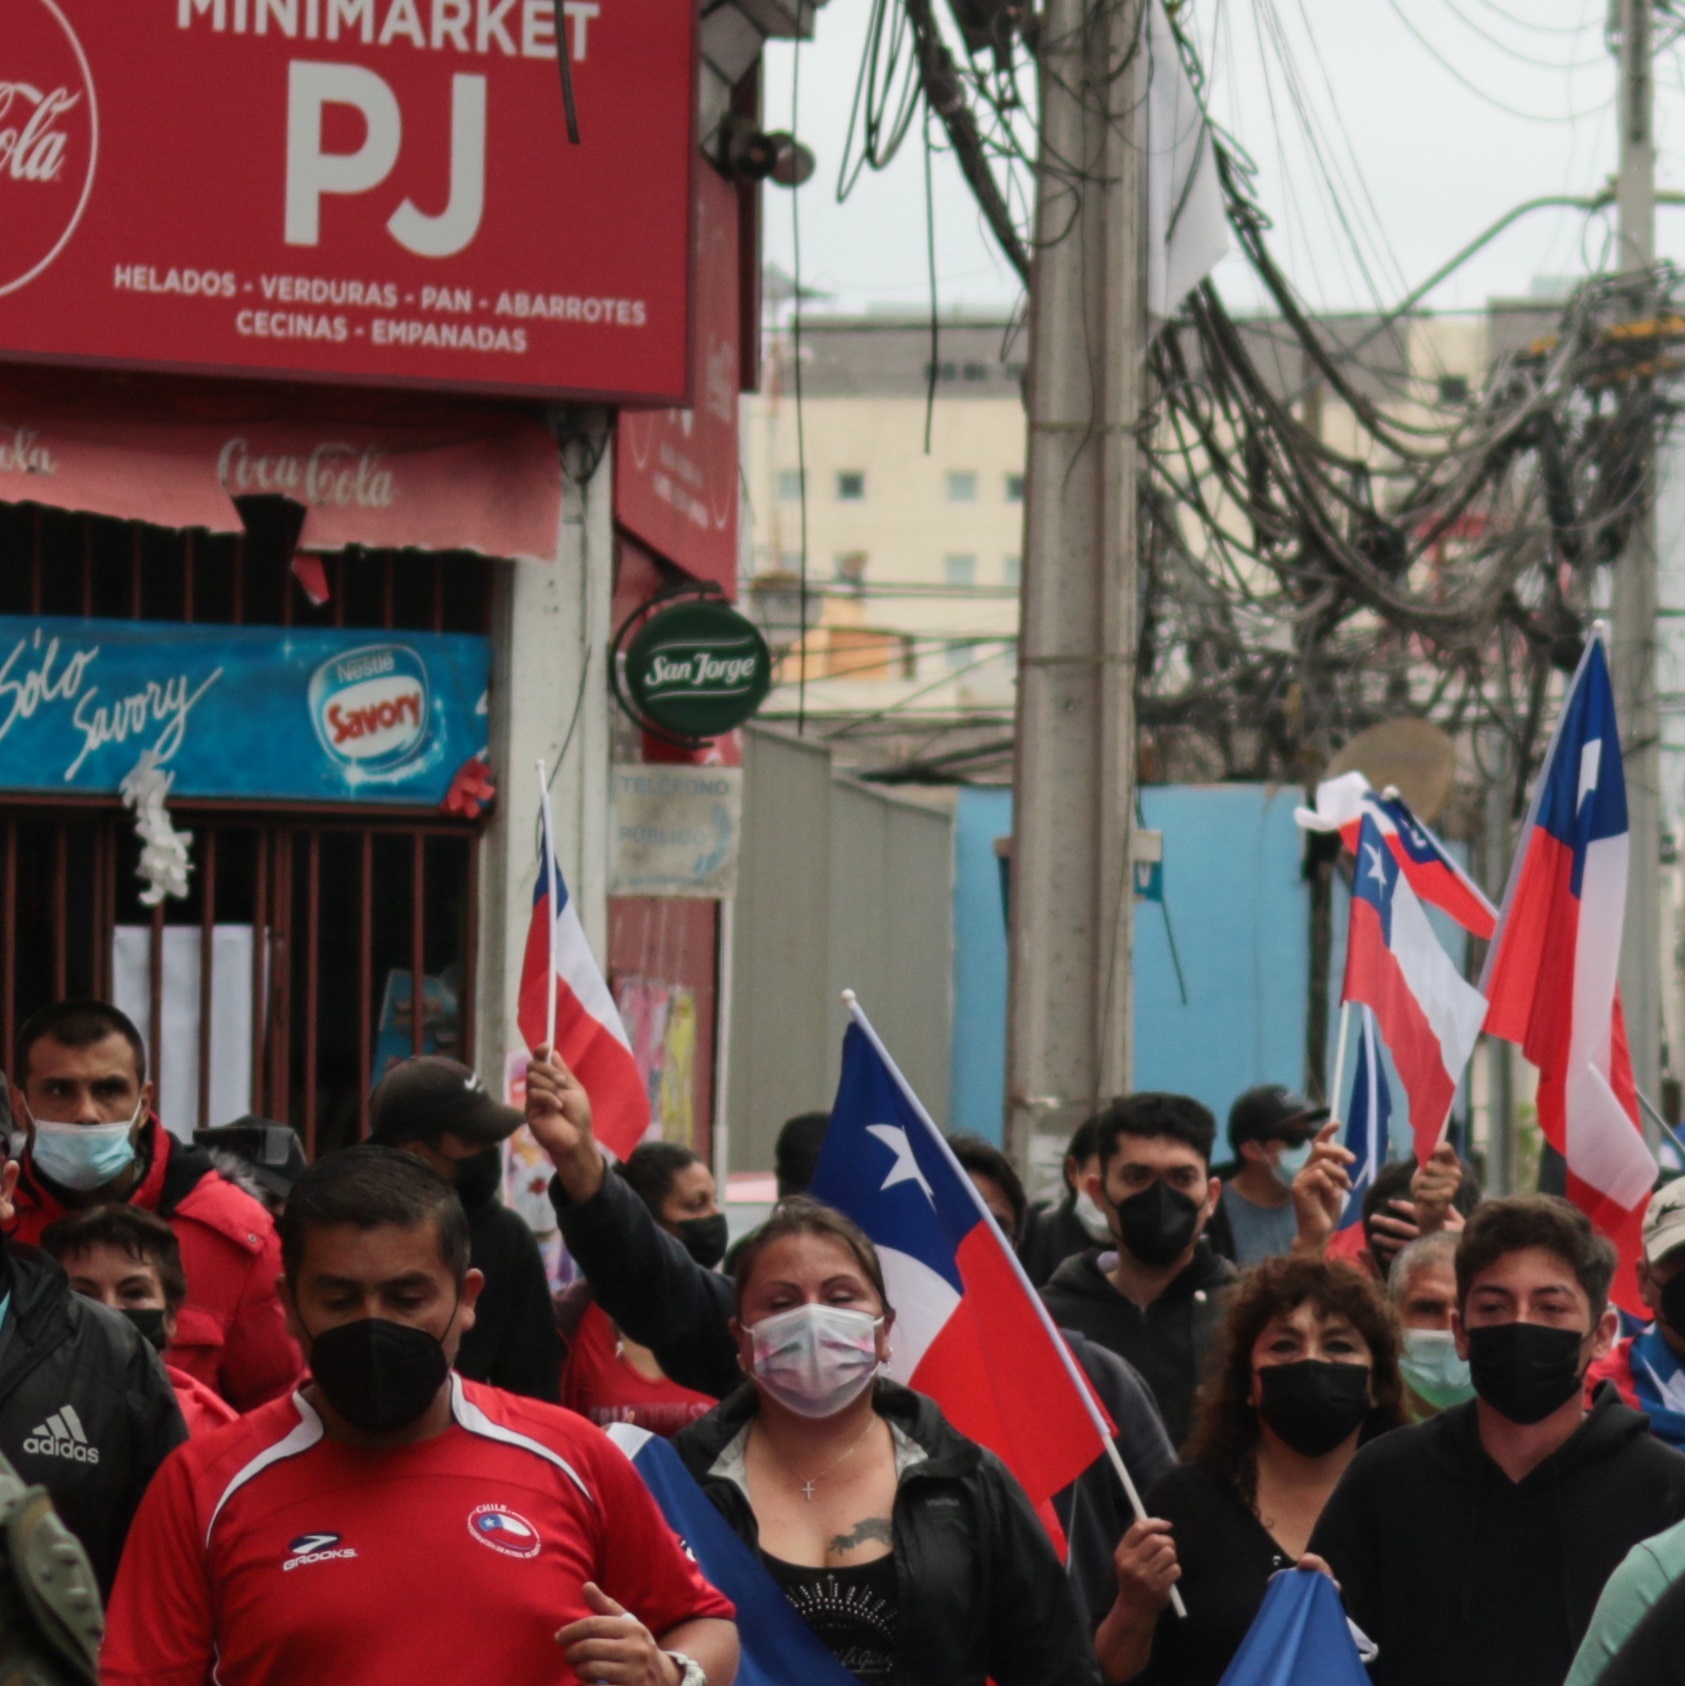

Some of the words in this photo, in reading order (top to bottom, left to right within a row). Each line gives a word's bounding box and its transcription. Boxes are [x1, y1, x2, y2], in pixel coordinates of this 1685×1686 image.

[283, 59, 488, 259] PJ
[114, 264, 236, 297] HELADOS
[260, 274, 398, 309] VERDURAS
[421, 285, 472, 313] PAN
[495, 291, 647, 327] ABARROTES
[236, 309, 347, 342] CECINAS
[371, 317, 528, 353] EMPANADAS
[645, 656, 691, 686] San
[690, 651, 757, 686] Jorge
[327, 689, 422, 745] Savory
[22, 1434, 100, 1464] adidas
[282, 1548, 356, 1572] BROOKS
